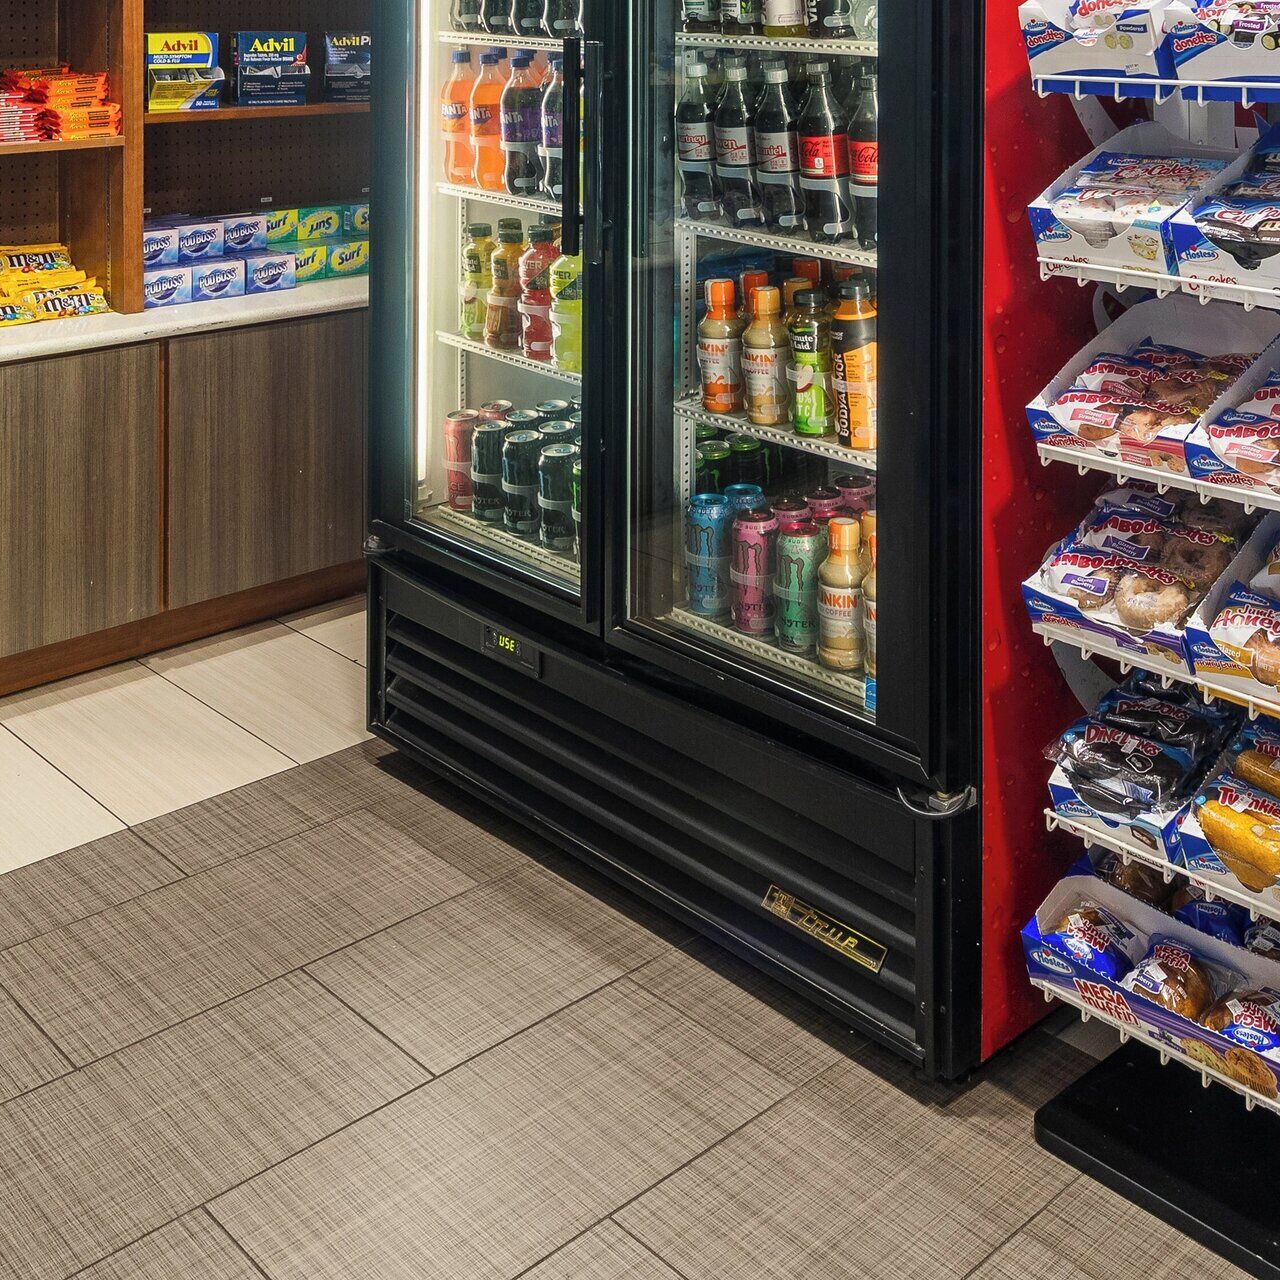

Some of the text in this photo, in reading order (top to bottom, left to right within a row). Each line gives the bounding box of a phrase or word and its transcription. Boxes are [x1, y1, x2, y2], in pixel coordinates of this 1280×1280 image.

[1238, 21, 1261, 29] Frosted
[161, 39, 198, 52] Advil
[250, 37, 295, 52] Advil
[330, 36, 360, 47] Advil
[1026, 30, 1066, 47] donettes
[1173, 32, 1217, 51] donettes
[338, 242, 363, 266] Surf
[1183, 248, 1218, 261] Hostess
[822, 593, 860, 609] NKIN'
[498, 634, 516, 652] USE
[1033, 951, 1073, 973] Hostess
[1073, 976, 1131, 1009] MEGA
[1081, 996, 1140, 1027] muffin
